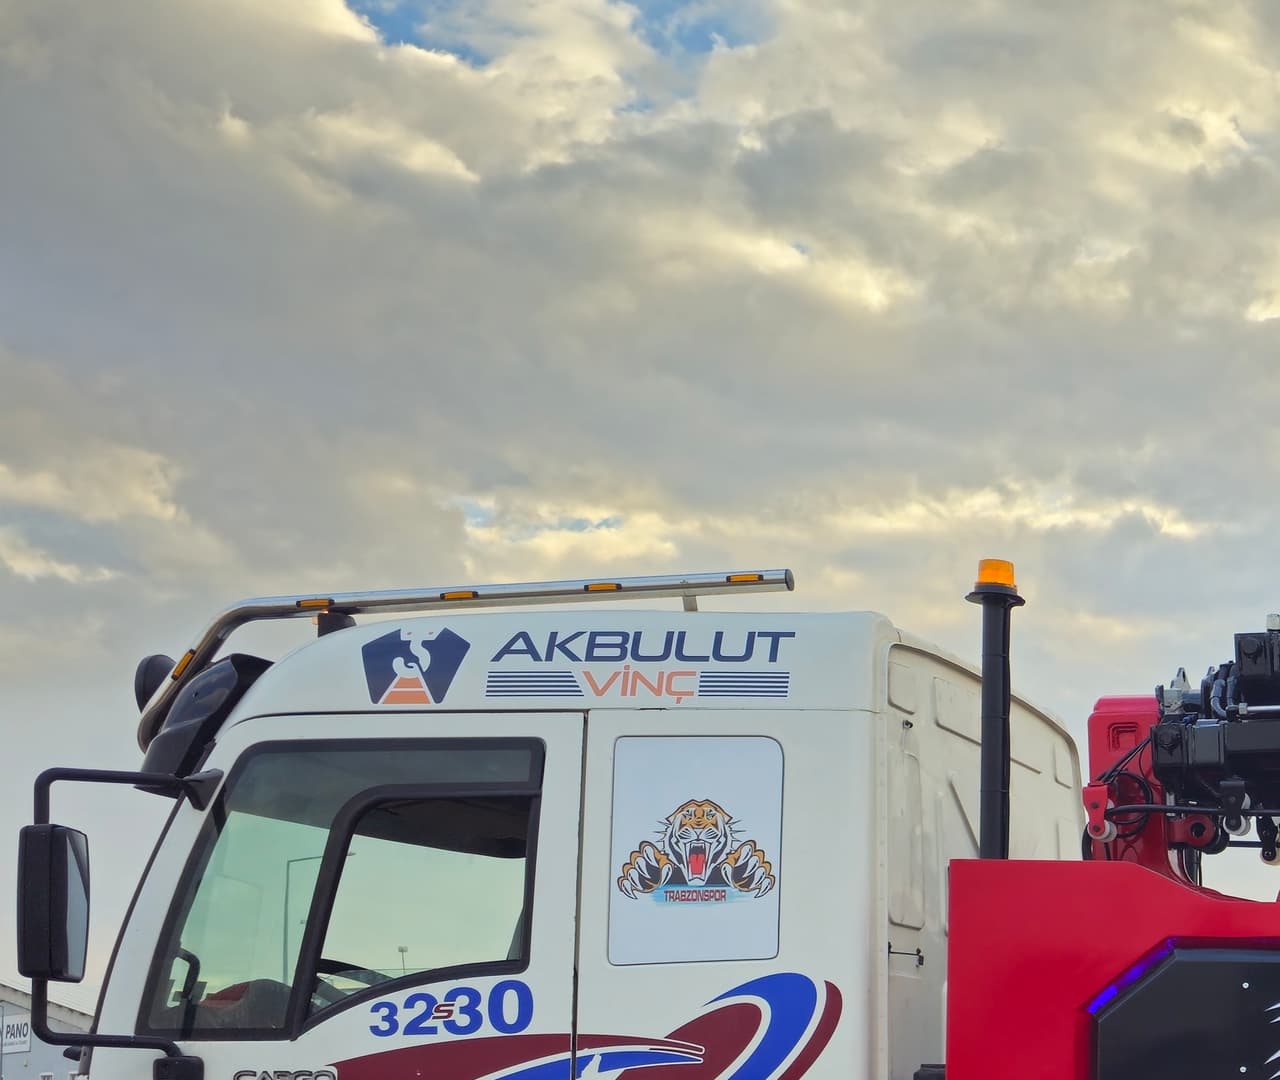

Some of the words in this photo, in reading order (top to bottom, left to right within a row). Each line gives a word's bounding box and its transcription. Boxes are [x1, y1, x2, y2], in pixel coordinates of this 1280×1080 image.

[490, 630, 796, 662] AKBULUT
[582, 664, 697, 704] VİNÇ
[664, 889, 727, 902] TRABZONSPOR
[6, 1022, 29, 1039] PANO
